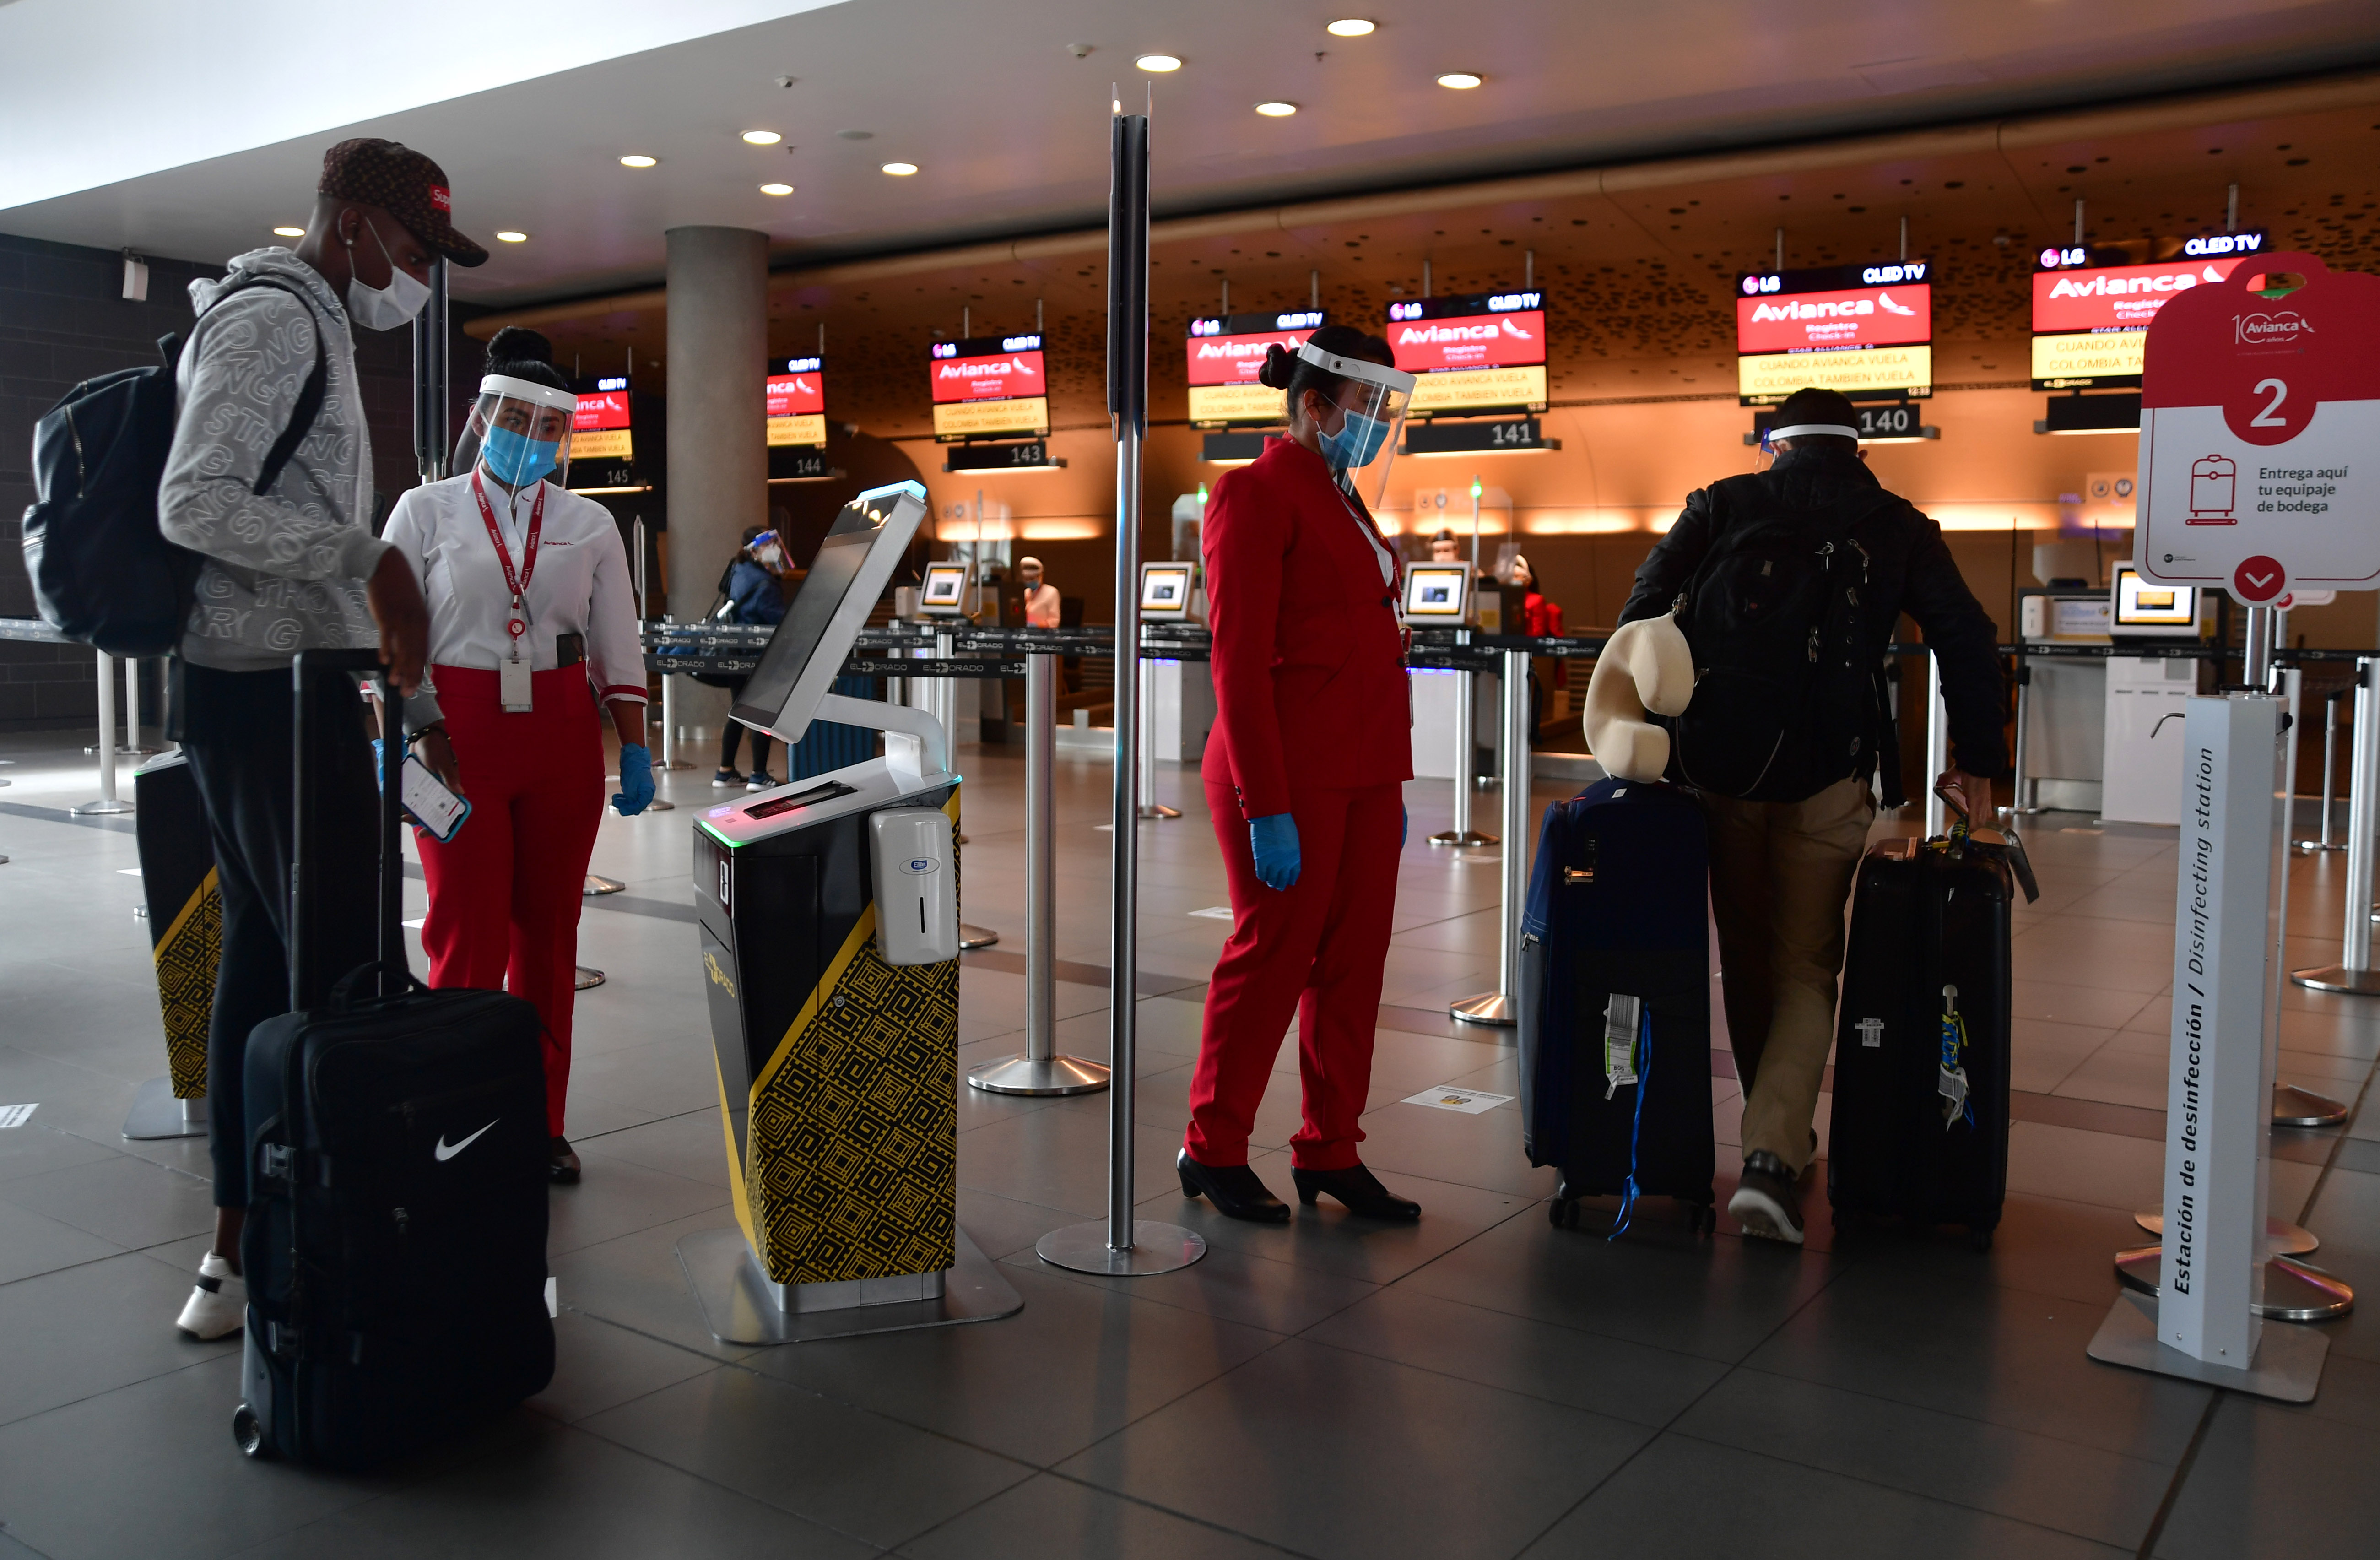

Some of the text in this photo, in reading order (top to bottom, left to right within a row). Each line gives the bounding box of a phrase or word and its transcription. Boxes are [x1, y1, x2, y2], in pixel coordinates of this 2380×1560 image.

[2185, 233, 2262, 255] OLED TV
[2061, 248, 2085, 265] LG
[1863, 264, 1925, 284] OLED TV
[1759, 276, 1780, 292] LG
[2049, 274, 2196, 299] Avianca
[1488, 293, 1540, 311] OLED TV
[1306, 312, 1323, 326] TV
[1751, 299, 1874, 323] Avianca
[1398, 323, 1499, 345] Avianca
[2245, 322, 2299, 334] Avianca
[2057, 341, 2115, 352] CUANDO
[1759, 353, 1908, 370] CUANDO AVIANCA VUELA
[2049, 358, 2121, 371] COLOMBIA
[939, 362, 1012, 379] Avianca
[1754, 370, 1915, 387] COLOMBIA TAMBIEN VUELA
[1411, 391, 1452, 403] OLOMBIA
[2250, 378, 2288, 427] 2
[1861, 409, 1909, 433] 140
[1492, 423, 1532, 444] 141
[1011, 445, 1041, 463] 143
[797, 458, 821, 474] 144
[2259, 466, 2348, 481] Entrega aquí
[607, 469, 628, 484] 145
[2258, 483, 2336, 497] tu equipaje
[2257, 500, 2328, 514] de bodega
[491, 529, 499, 544] Avianca
[505, 565, 515, 585] Avianca
[2174, 747, 2213, 1296] Estación de desinfección / Disinfecting station
